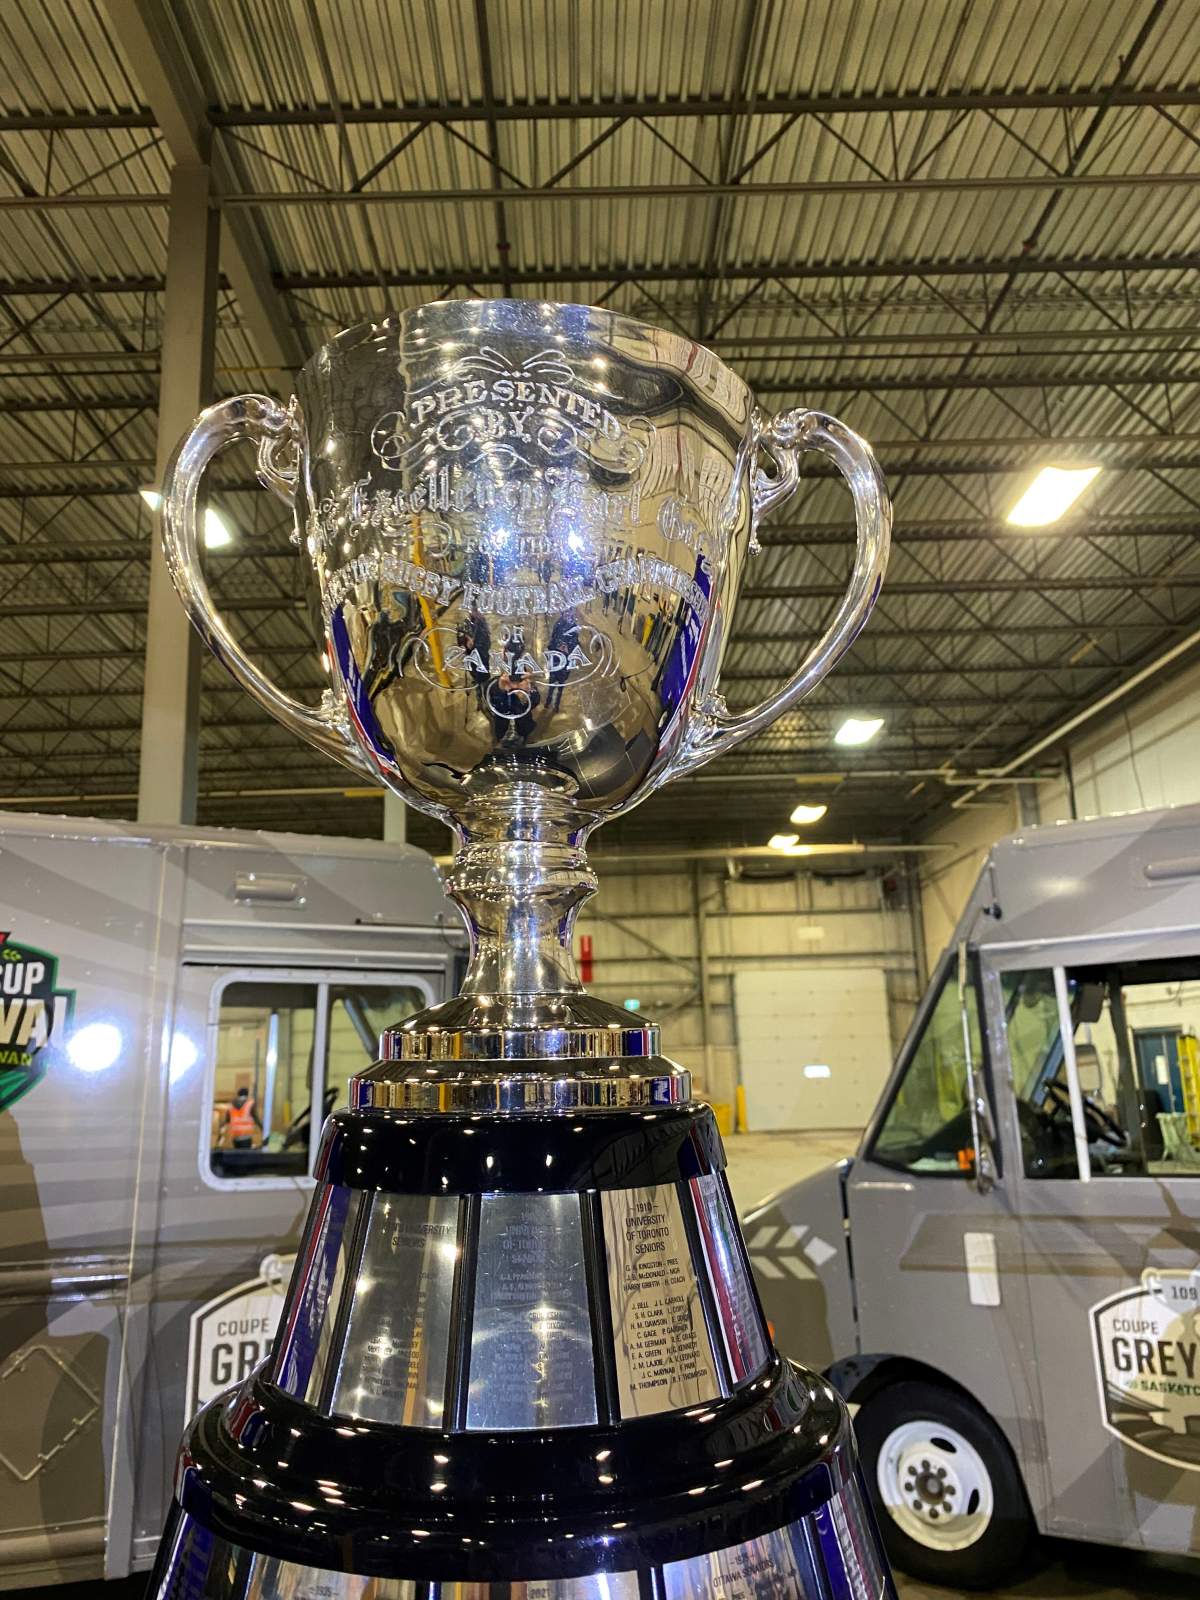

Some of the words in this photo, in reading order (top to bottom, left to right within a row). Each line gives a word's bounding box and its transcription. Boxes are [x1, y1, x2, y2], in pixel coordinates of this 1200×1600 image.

[410, 379, 622, 441] PRESENTED
[443, 644, 593, 676] CANADA
[0, 961, 45, 995] UP
[626, 1215, 665, 1227] UNIVERSITY
[626, 1232, 635, 1241] OF
[638, 1227, 669, 1240] TORONTO
[635, 1242, 665, 1254] SENIORS
[639, 1270, 665, 1279] McDONALD
[217, 1317, 270, 1337] COUPE
[1113, 1319, 1160, 1335] COUPE
[210, 1340, 275, 1386] GR
[1111, 1336, 1197, 1380] GREY
[713, 1570, 742, 1588] OTTAWA
